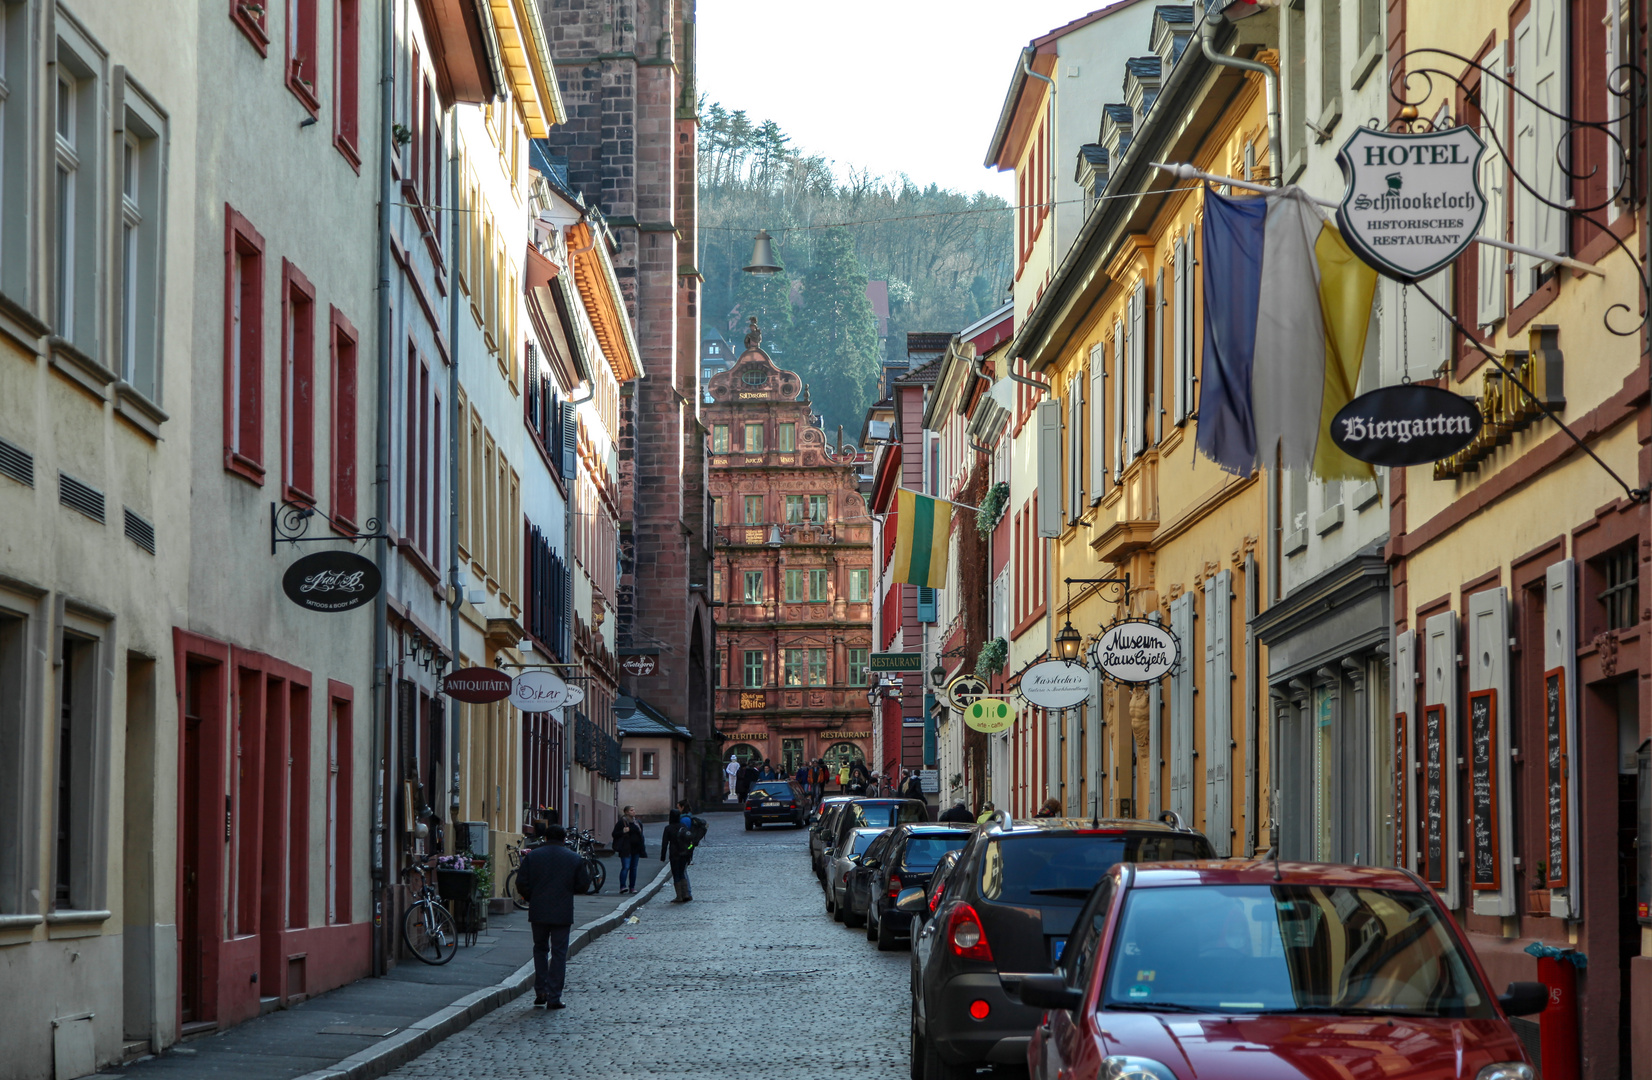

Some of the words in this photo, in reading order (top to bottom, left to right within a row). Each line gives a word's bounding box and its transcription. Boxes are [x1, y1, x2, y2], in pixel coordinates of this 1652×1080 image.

[1363, 144, 1470, 166] HOTEL
[1354, 191, 1475, 213] Schnookeloch
[1367, 218, 1464, 230] HISTORISCHES
[1372, 234, 1460, 246] RESTAURANT
[1341, 413, 1473, 444] Biergarten
[306, 599, 328, 609] TATTOOS
[349, 598, 359, 606] ART
[1106, 628, 1166, 651] Museum
[871, 657, 920, 667] RESTAURANT
[445, 680, 510, 692] ANTIQUITÄTEN
[519, 685, 561, 700] Oskar
[740, 732, 769, 740] RITTER
[820, 731, 871, 739] RESTAURANT
